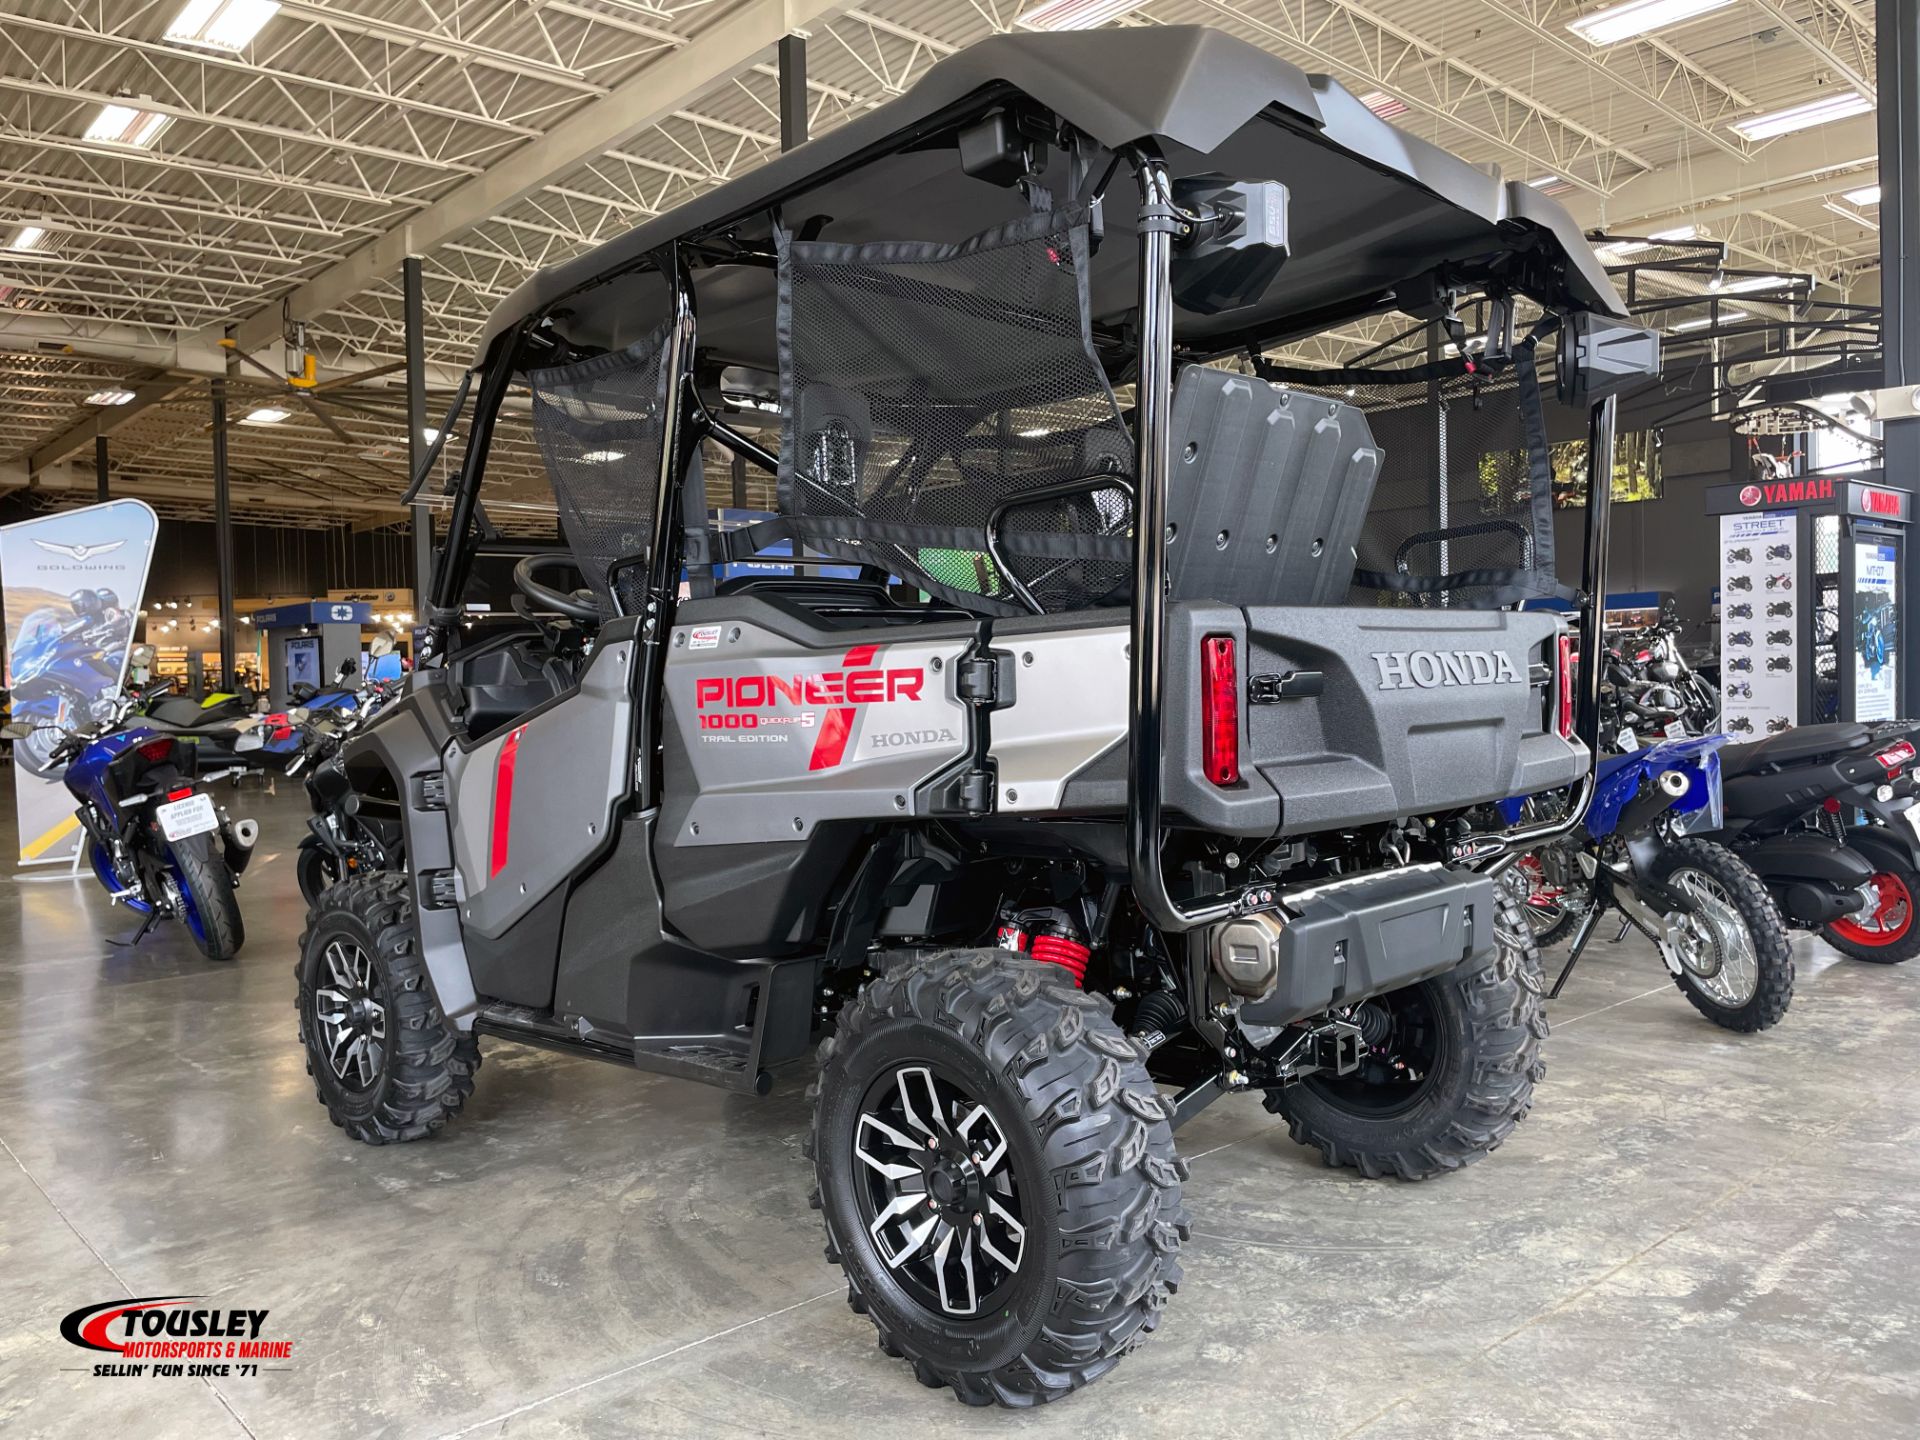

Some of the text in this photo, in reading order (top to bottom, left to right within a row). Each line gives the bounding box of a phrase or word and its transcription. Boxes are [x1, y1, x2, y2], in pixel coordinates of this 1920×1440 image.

[1763, 479, 1836, 504] YAMAH
[1870, 490, 1901, 516] YAMAHA
[1733, 519, 1785, 531] STREET
[291, 640, 315, 650] POLARIS
[1371, 650, 1523, 690] HONDA
[696, 667, 925, 709] PIONEER
[698, 713, 759, 729] 1000
[701, 734, 789, 743] TRAIL EDITION
[871, 728, 957, 748] HONDA
